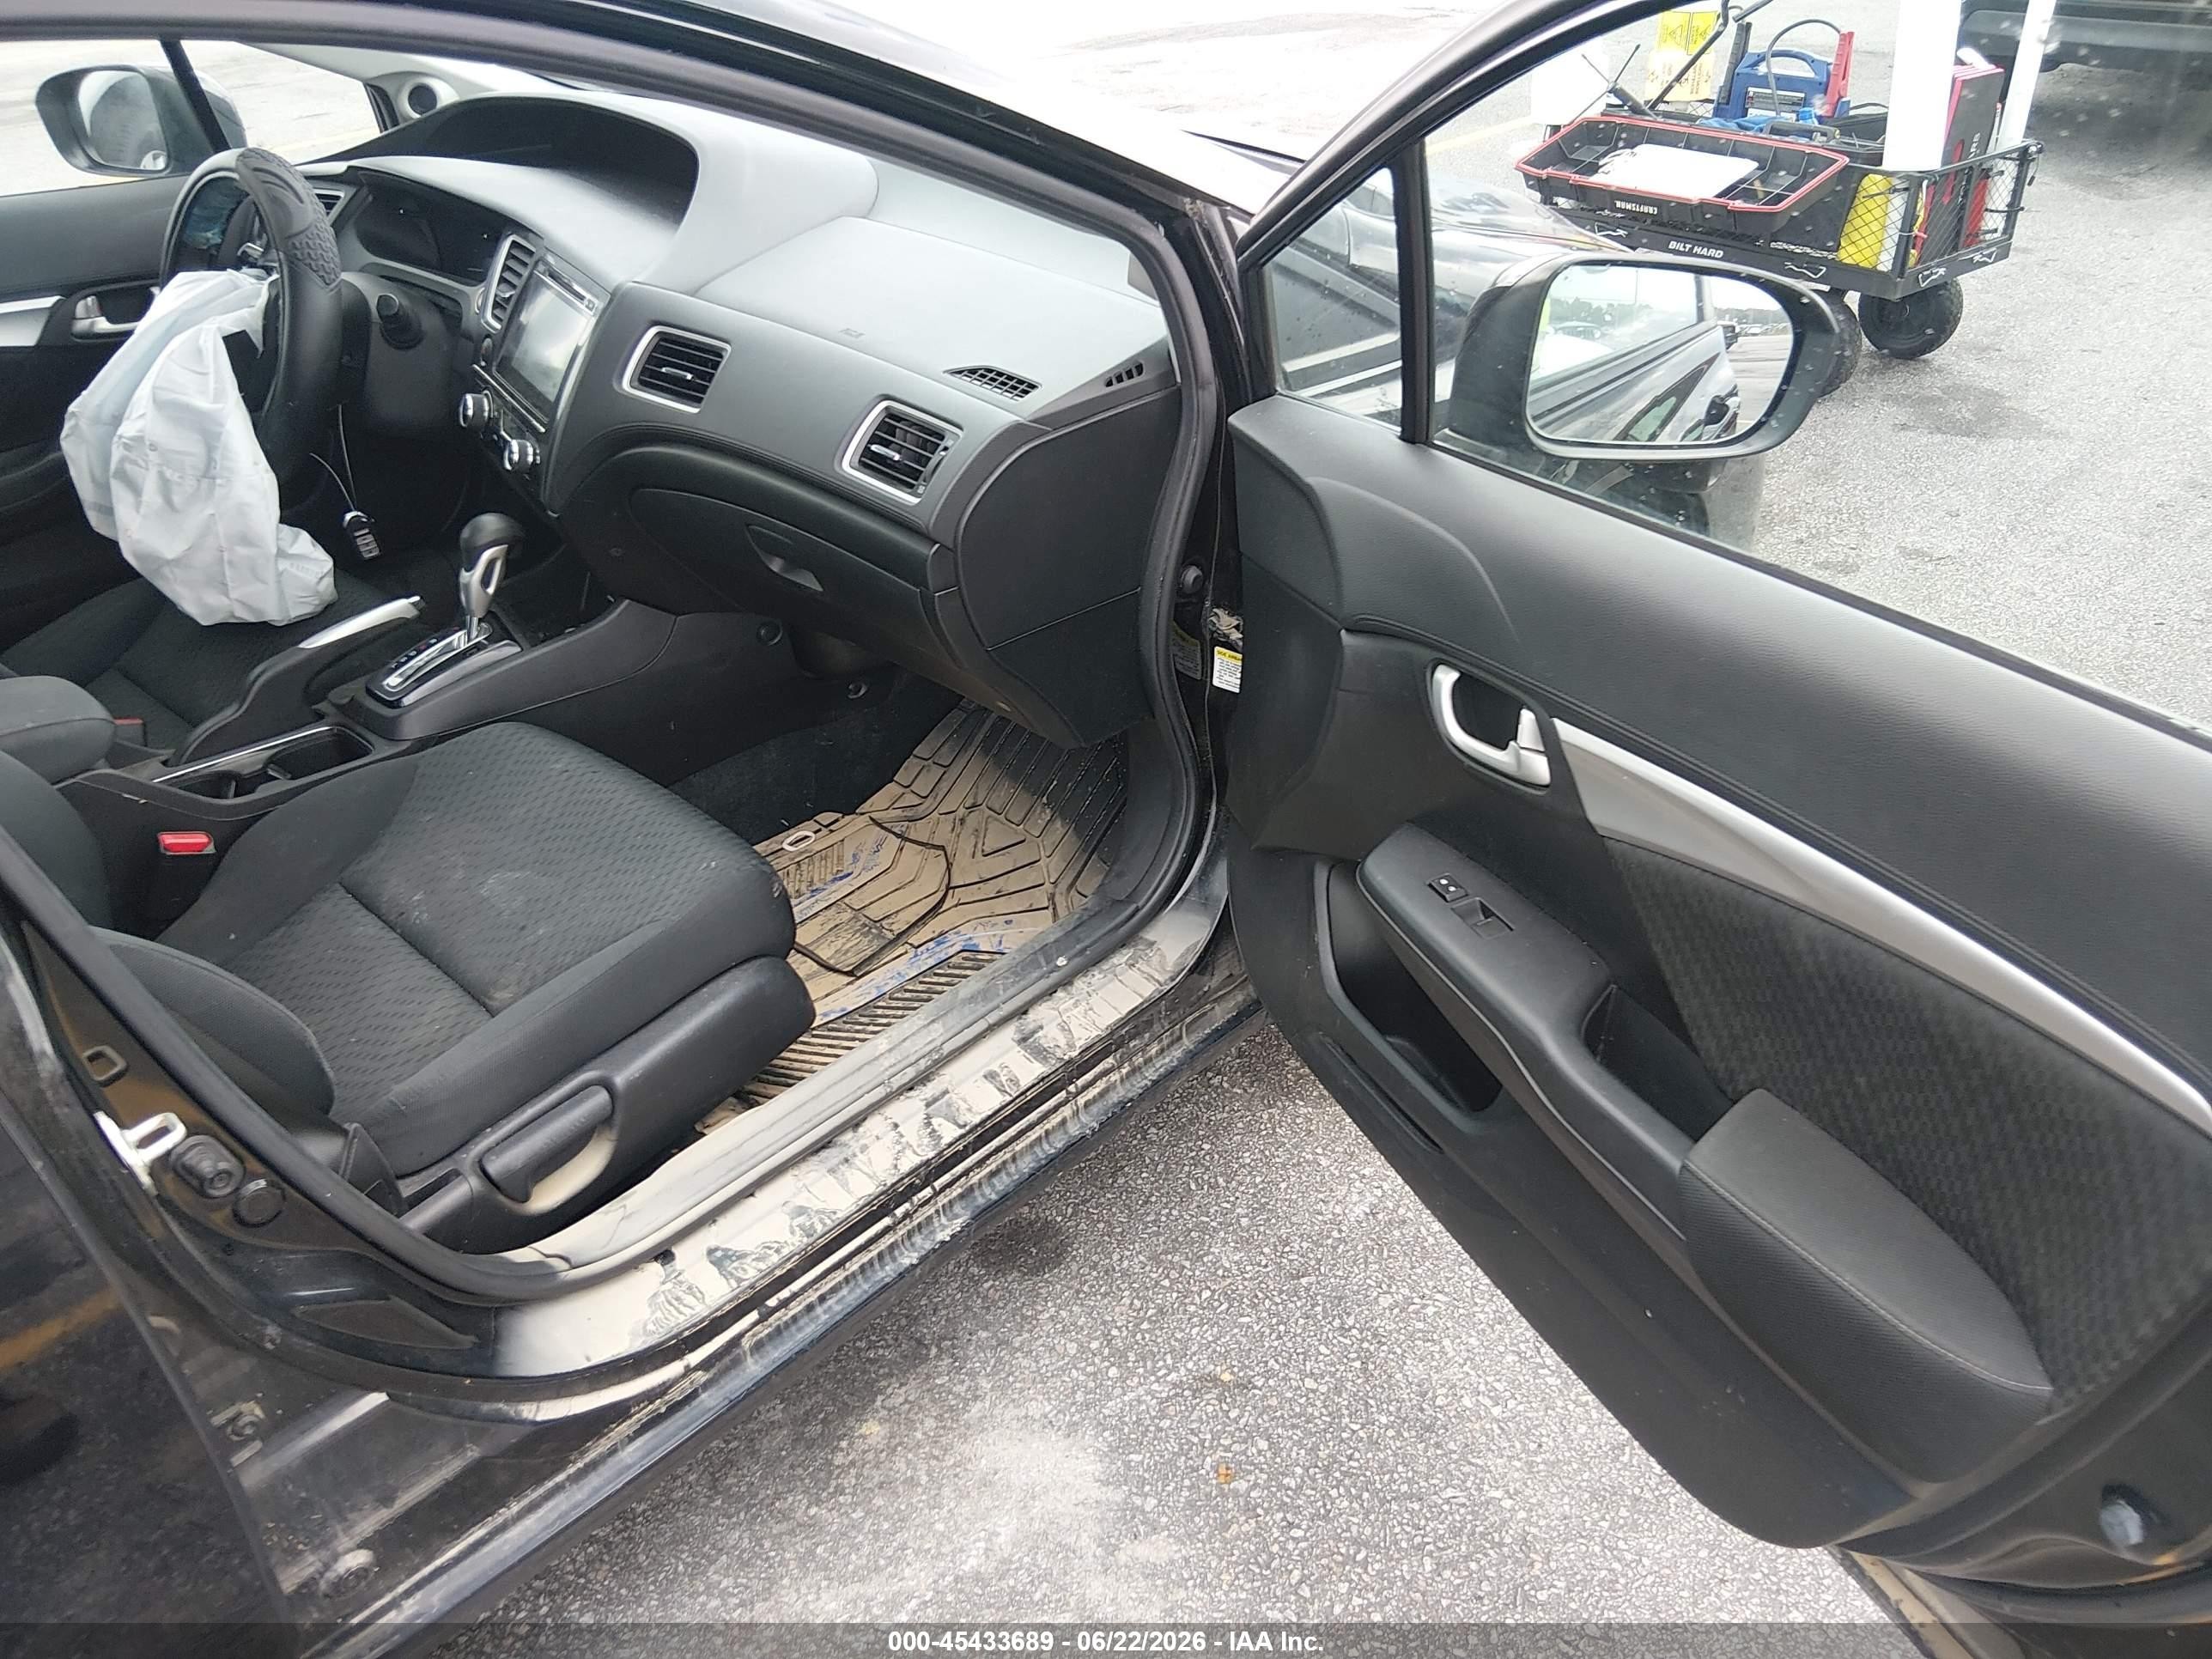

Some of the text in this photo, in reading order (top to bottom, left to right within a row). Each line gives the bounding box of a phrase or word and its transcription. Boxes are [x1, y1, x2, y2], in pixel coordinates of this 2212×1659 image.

[1614, 200, 1658, 215] CRAFTSMAN
[1668, 240, 1724, 258] BILT HARD
